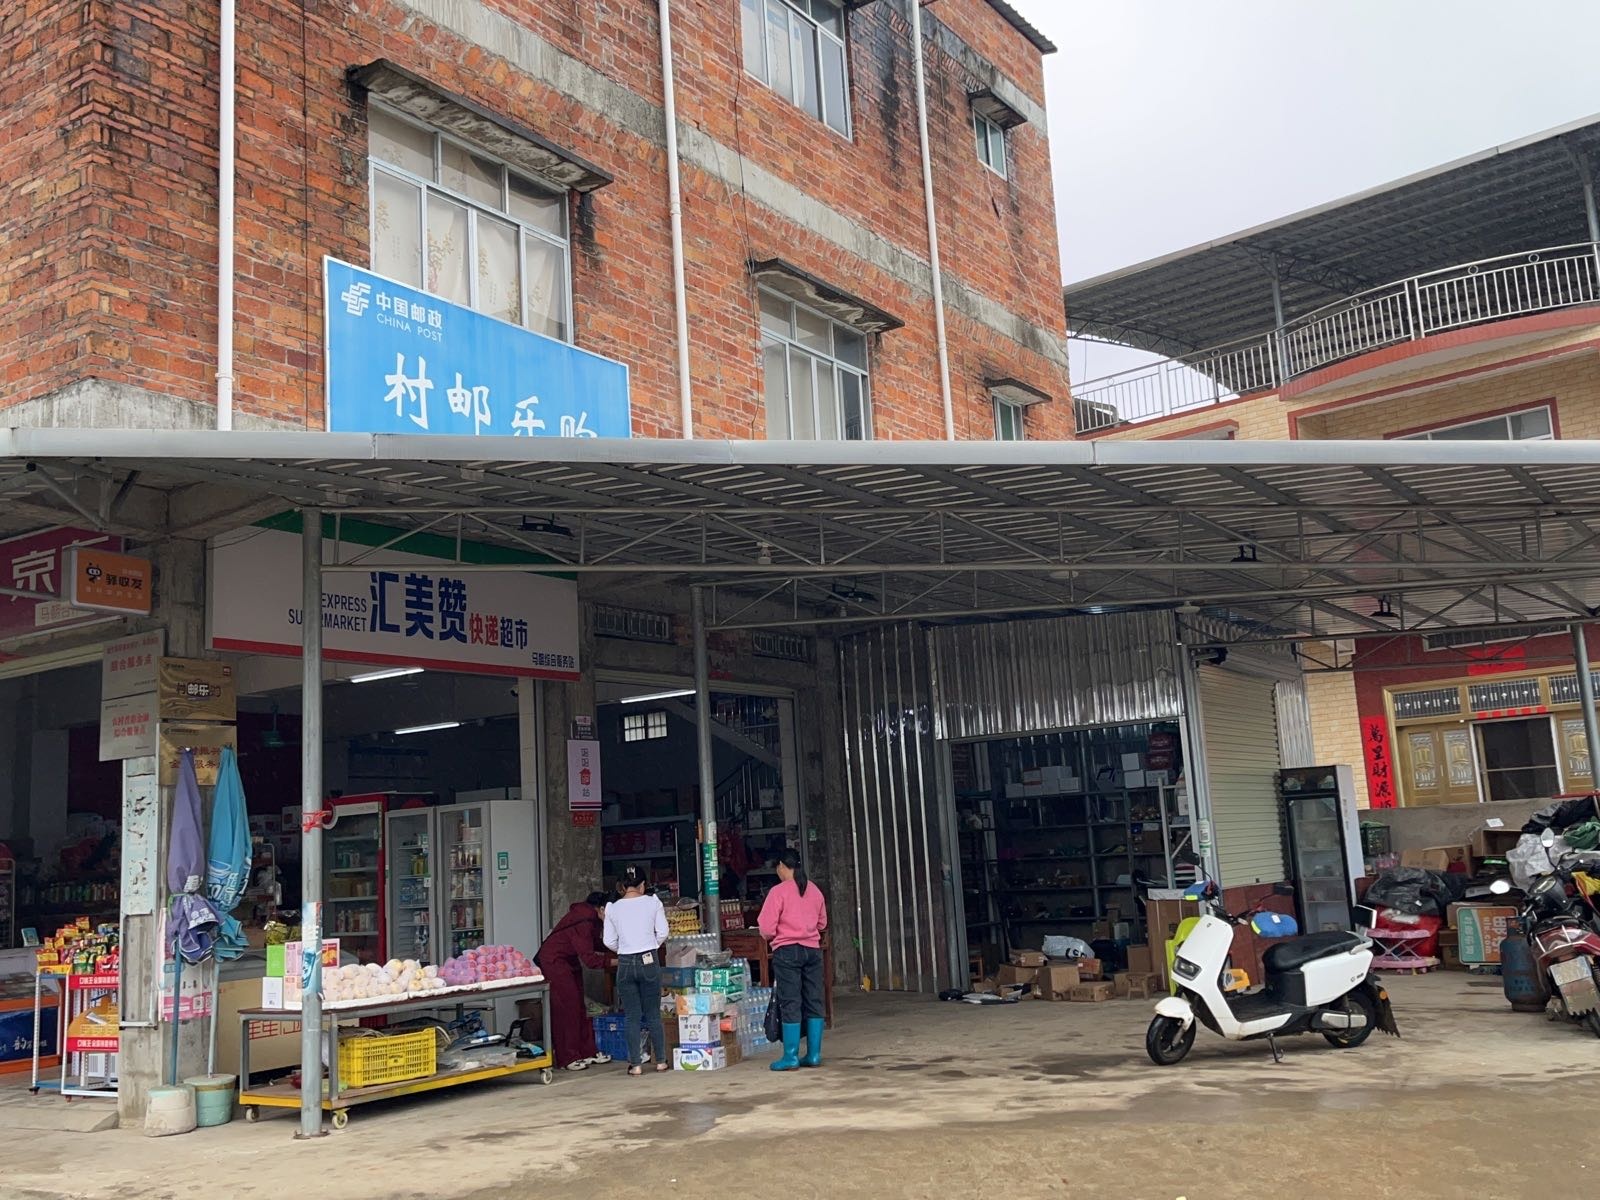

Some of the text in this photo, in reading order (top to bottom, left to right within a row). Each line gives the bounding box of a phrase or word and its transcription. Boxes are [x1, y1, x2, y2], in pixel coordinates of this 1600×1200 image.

[376, 291, 443, 331] 中国邮政
[376, 313, 443, 343] CHINA POST
[321, 592, 367, 613] EXPRESS
[369, 571, 467, 644] 汇美赞
[288, 608, 367, 632] SUMARKET
[469, 612, 528, 650] 快递超市
